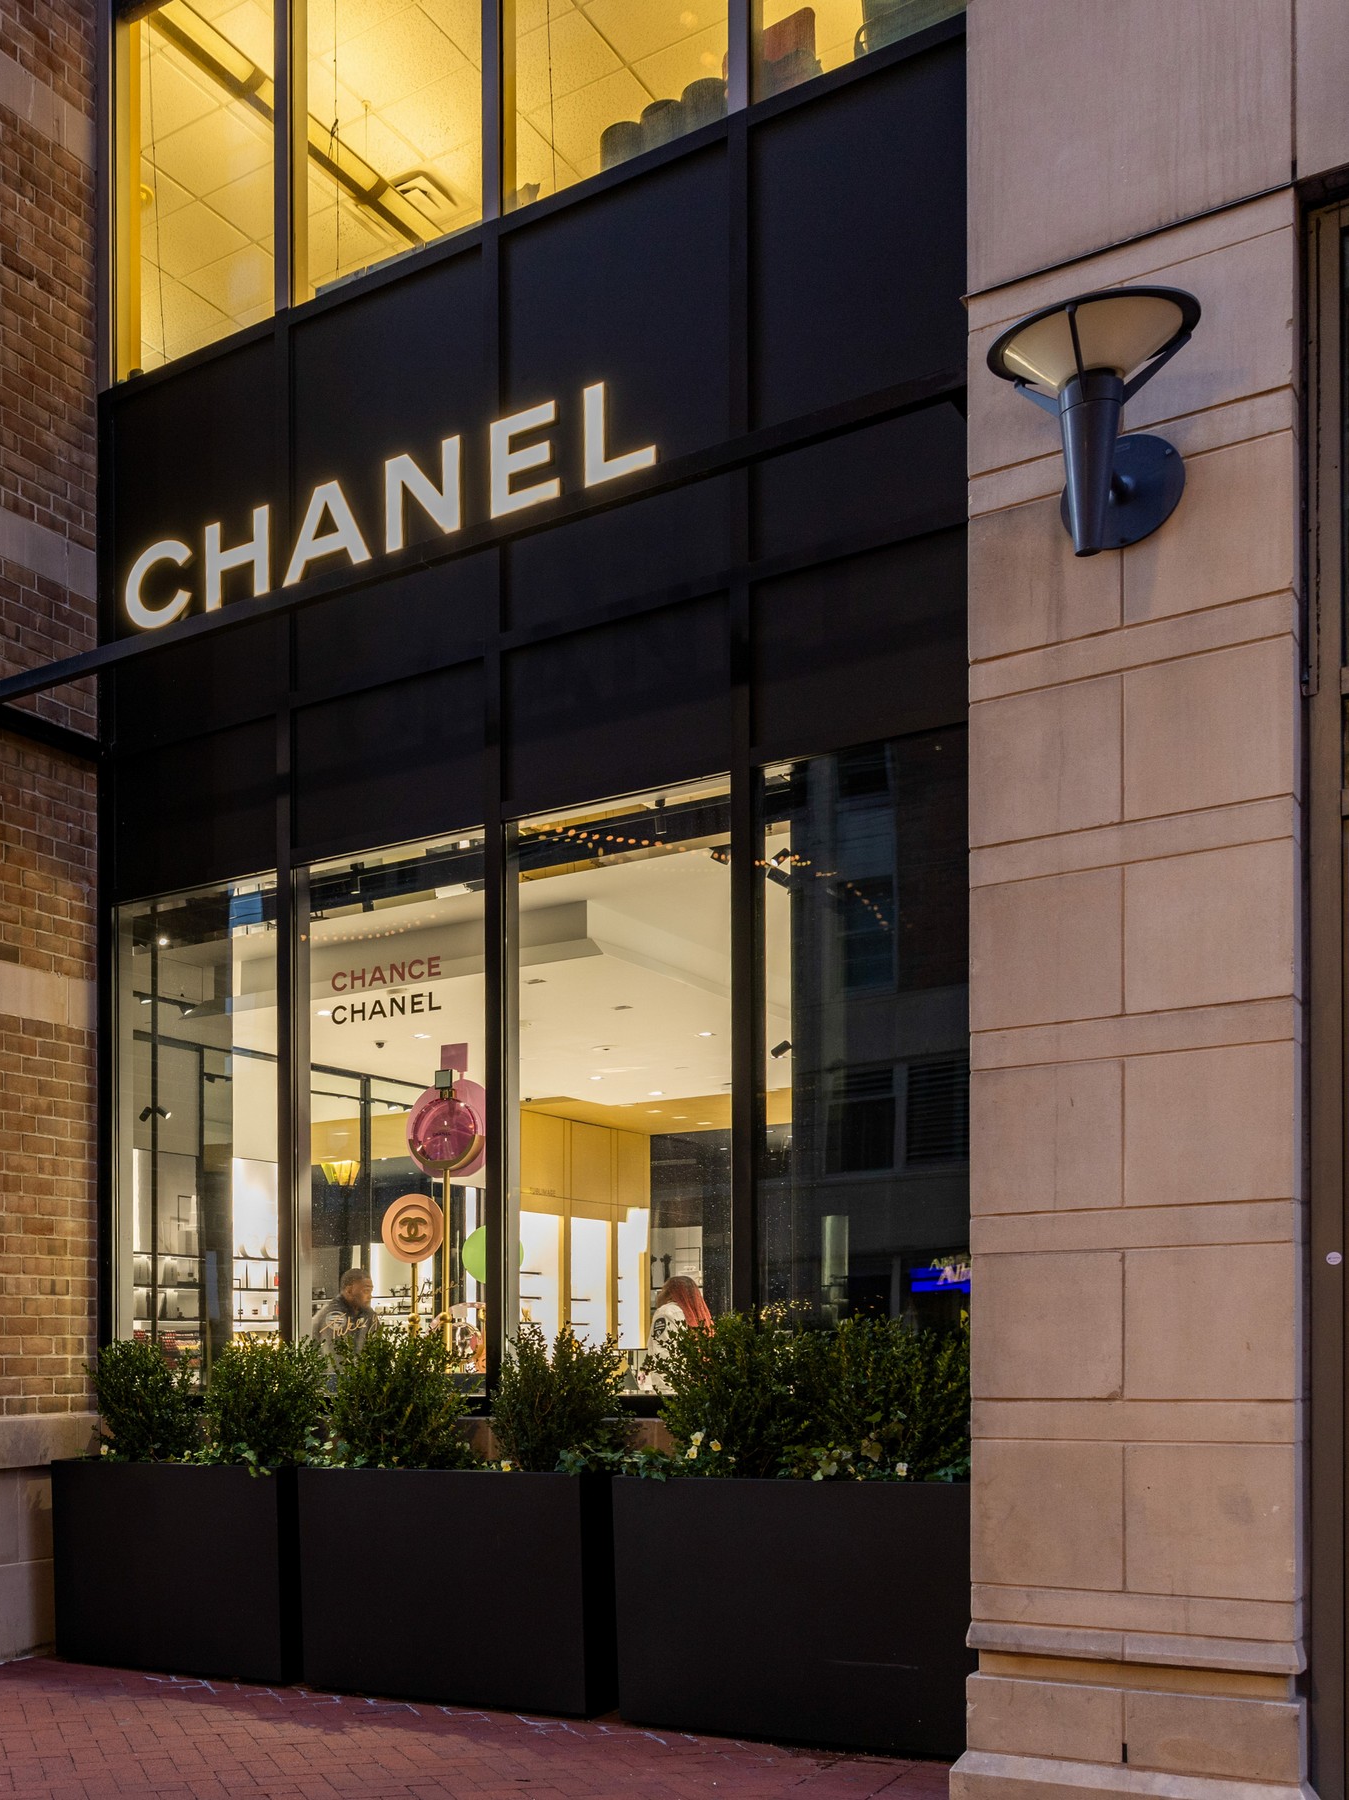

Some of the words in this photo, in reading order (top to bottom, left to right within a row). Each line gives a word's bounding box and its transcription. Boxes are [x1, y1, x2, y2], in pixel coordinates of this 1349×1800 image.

[125, 381, 657, 630] CHANEL
[331, 955, 442, 992] CHANCE
[331, 991, 442, 1025] CHANEL
